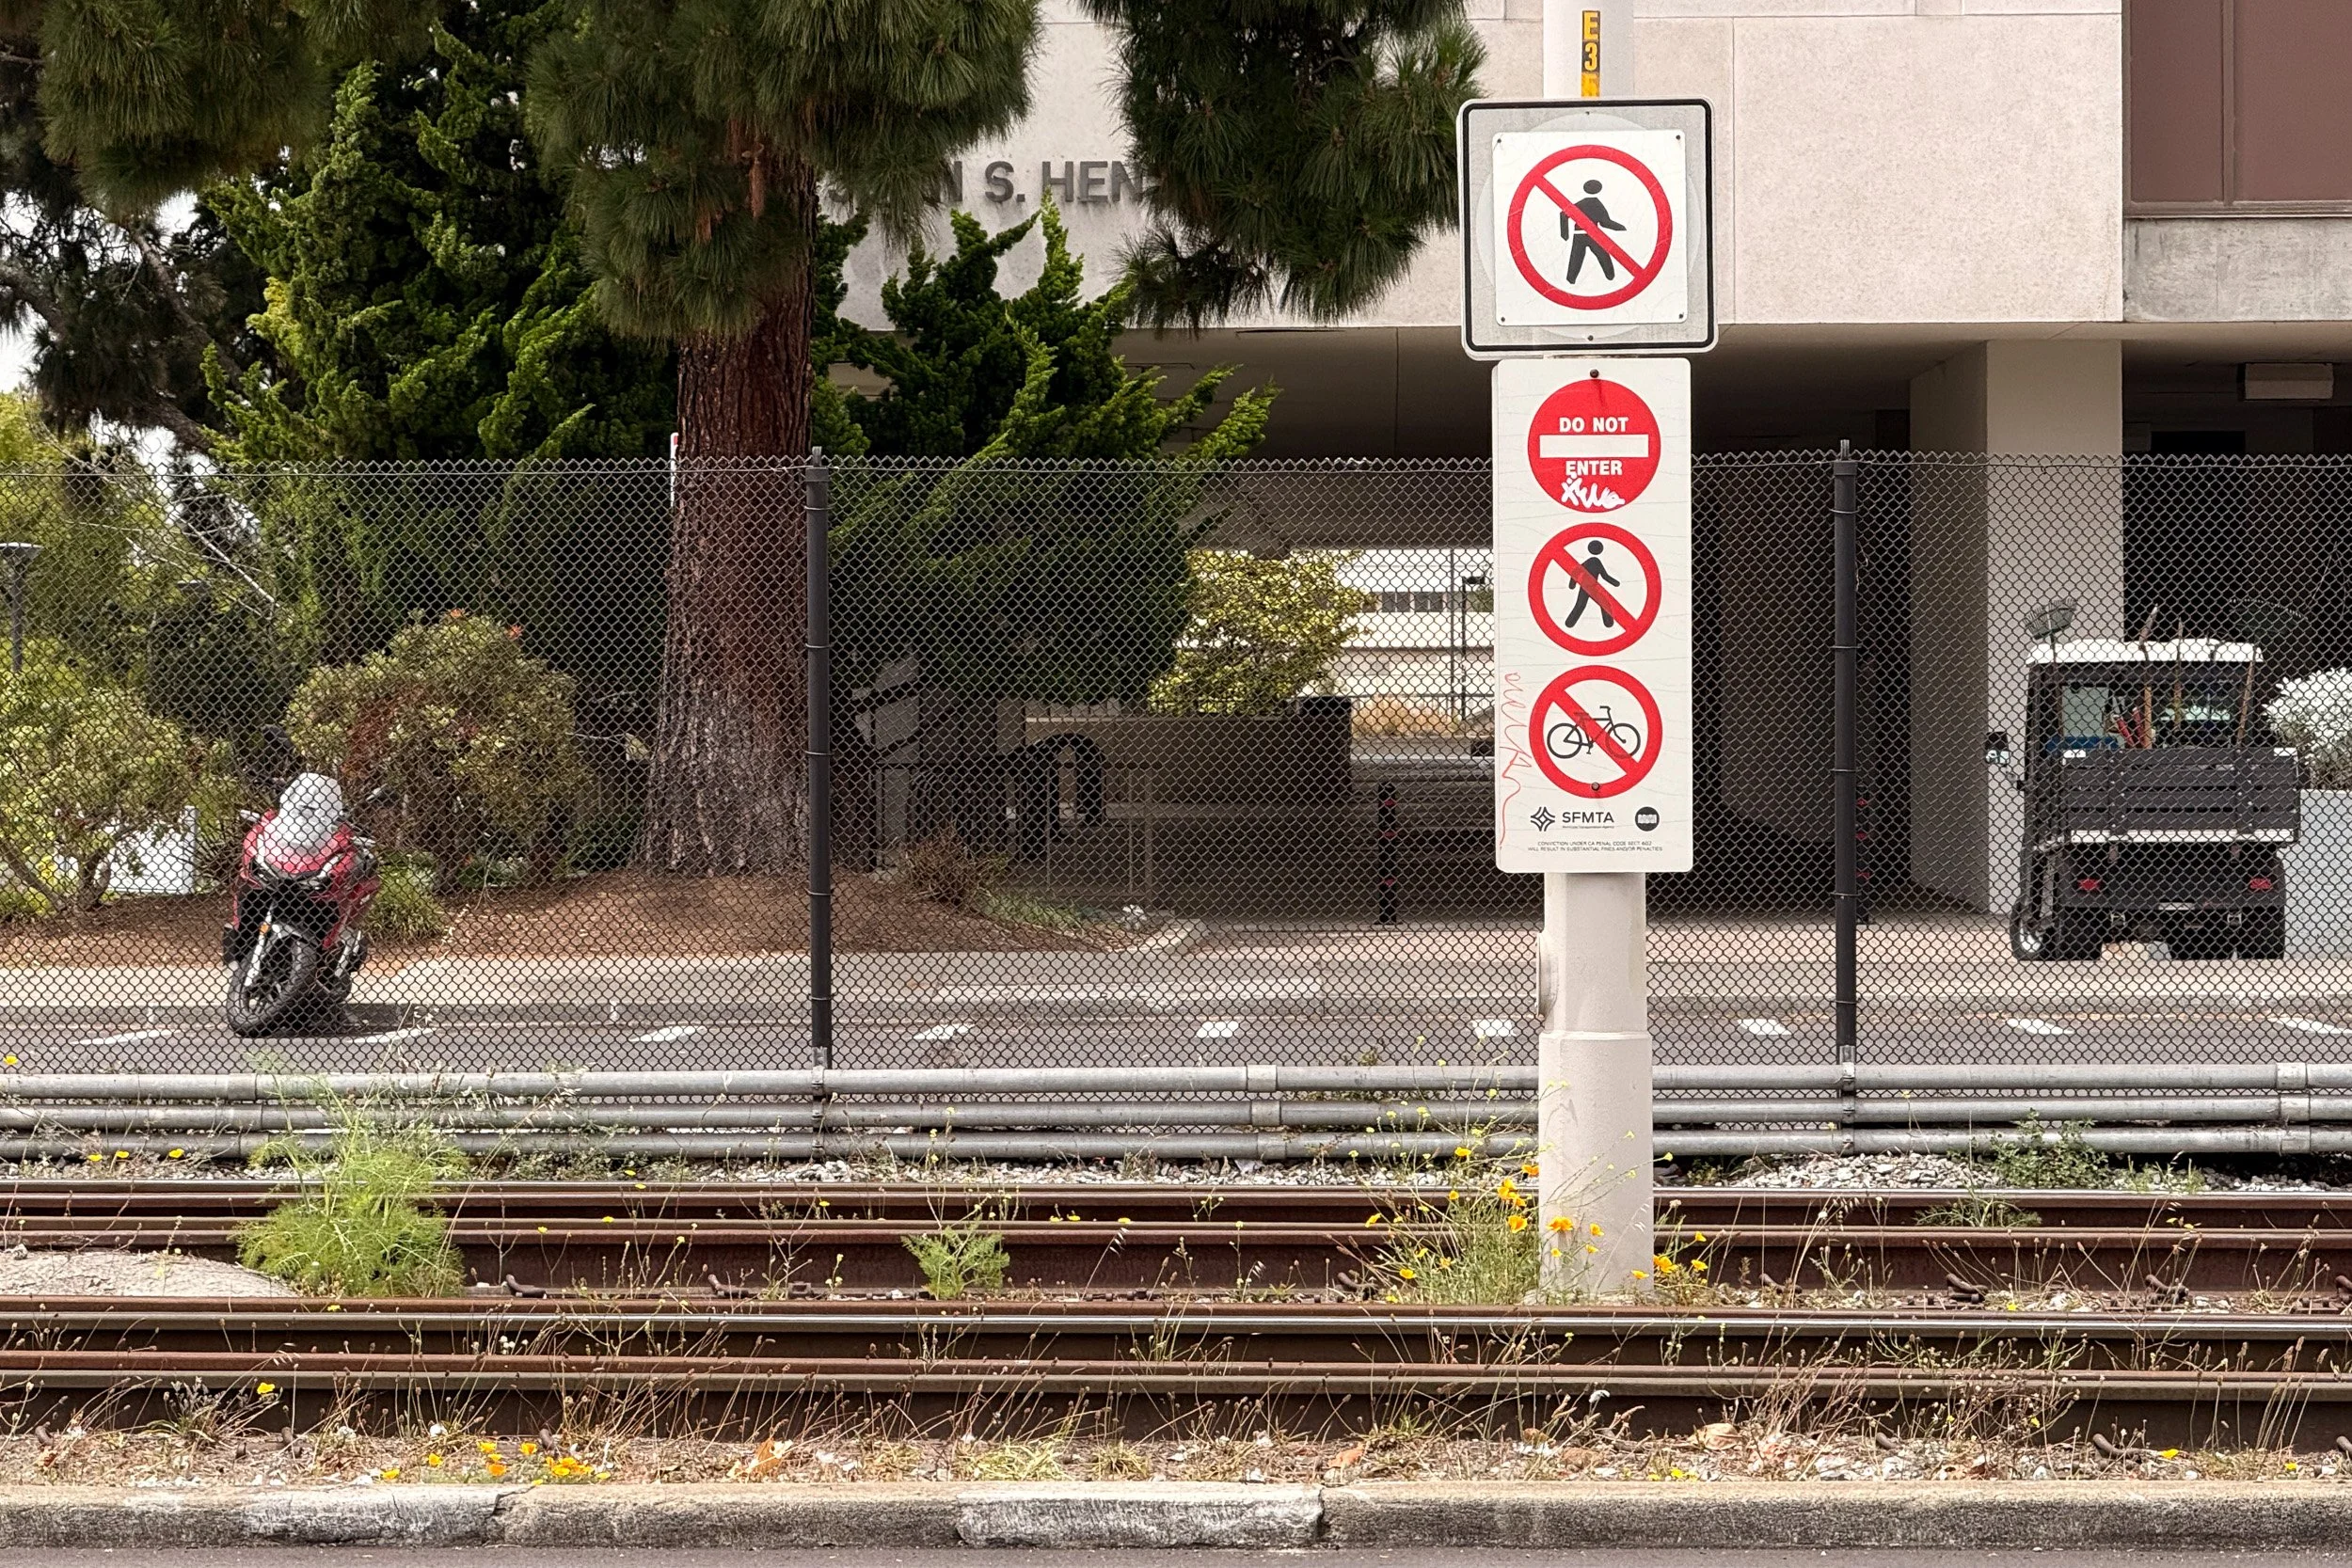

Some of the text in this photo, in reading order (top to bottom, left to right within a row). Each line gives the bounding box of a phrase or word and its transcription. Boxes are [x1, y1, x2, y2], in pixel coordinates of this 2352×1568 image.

[984, 161, 1025, 203] S.
[1559, 417, 1629, 433] DO NOT
[1565, 460, 1623, 476] ENTER
[1562, 812, 1614, 823] SFMTA
